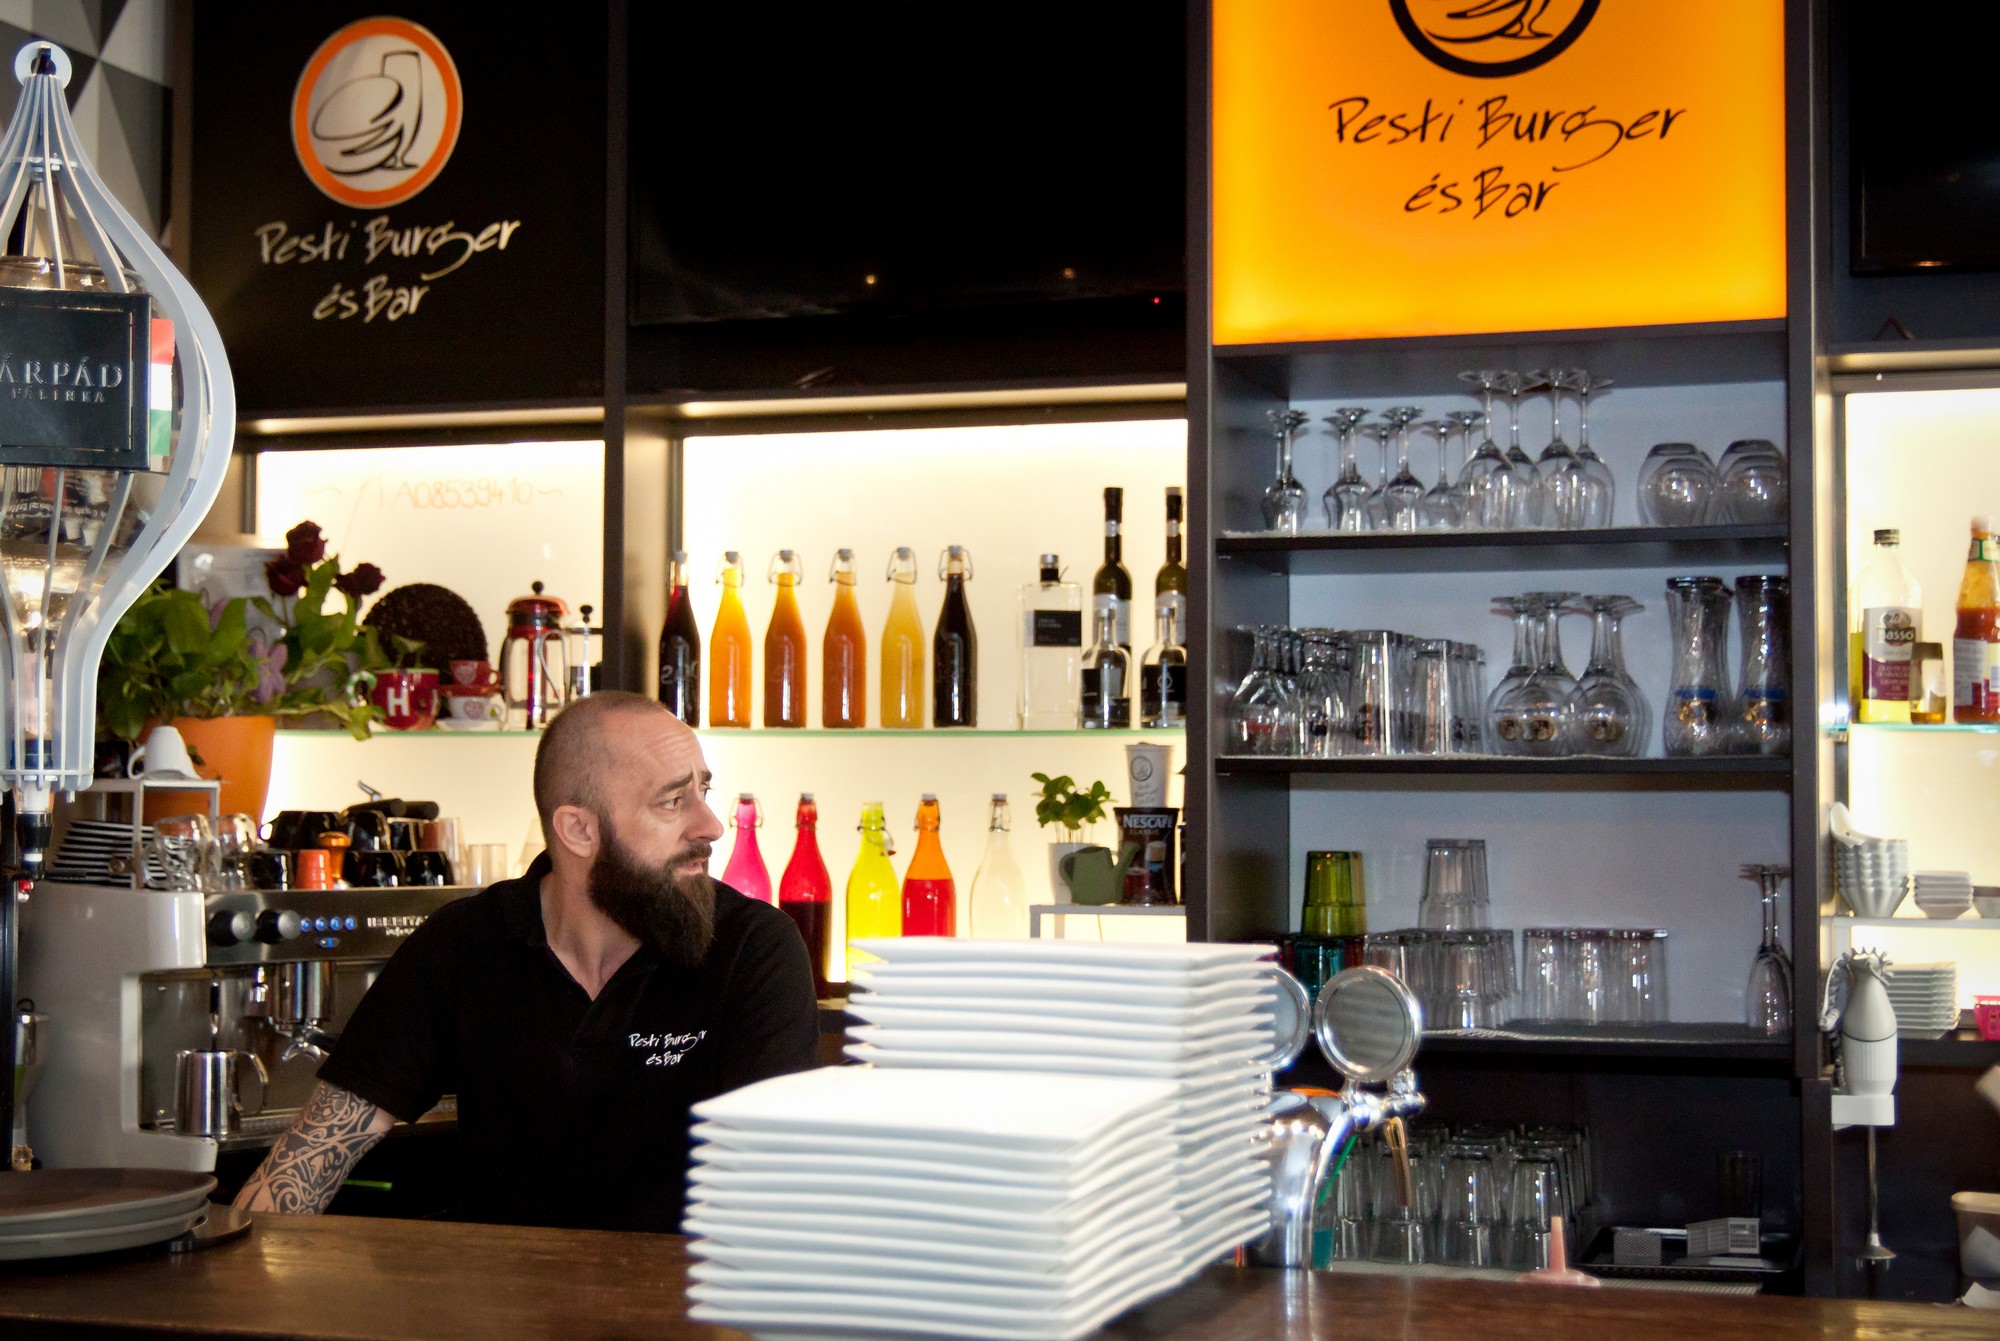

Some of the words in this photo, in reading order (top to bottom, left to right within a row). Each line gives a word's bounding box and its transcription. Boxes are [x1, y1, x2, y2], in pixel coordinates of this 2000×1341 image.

[1328, 96, 1464, 144] Pesti
[1476, 95, 1687, 172] Burger
[1404, 173, 1462, 213] és
[1472, 165, 1560, 220] Bar
[255, 220, 357, 264] Pesti
[363, 215, 521, 281] Burger
[312, 282, 359, 320] és
[362, 274, 430, 323] Bar
[628, 1033, 662, 1047] Pesti
[645, 1053, 662, 1065] és
[663, 1050, 684, 1067] Bar
